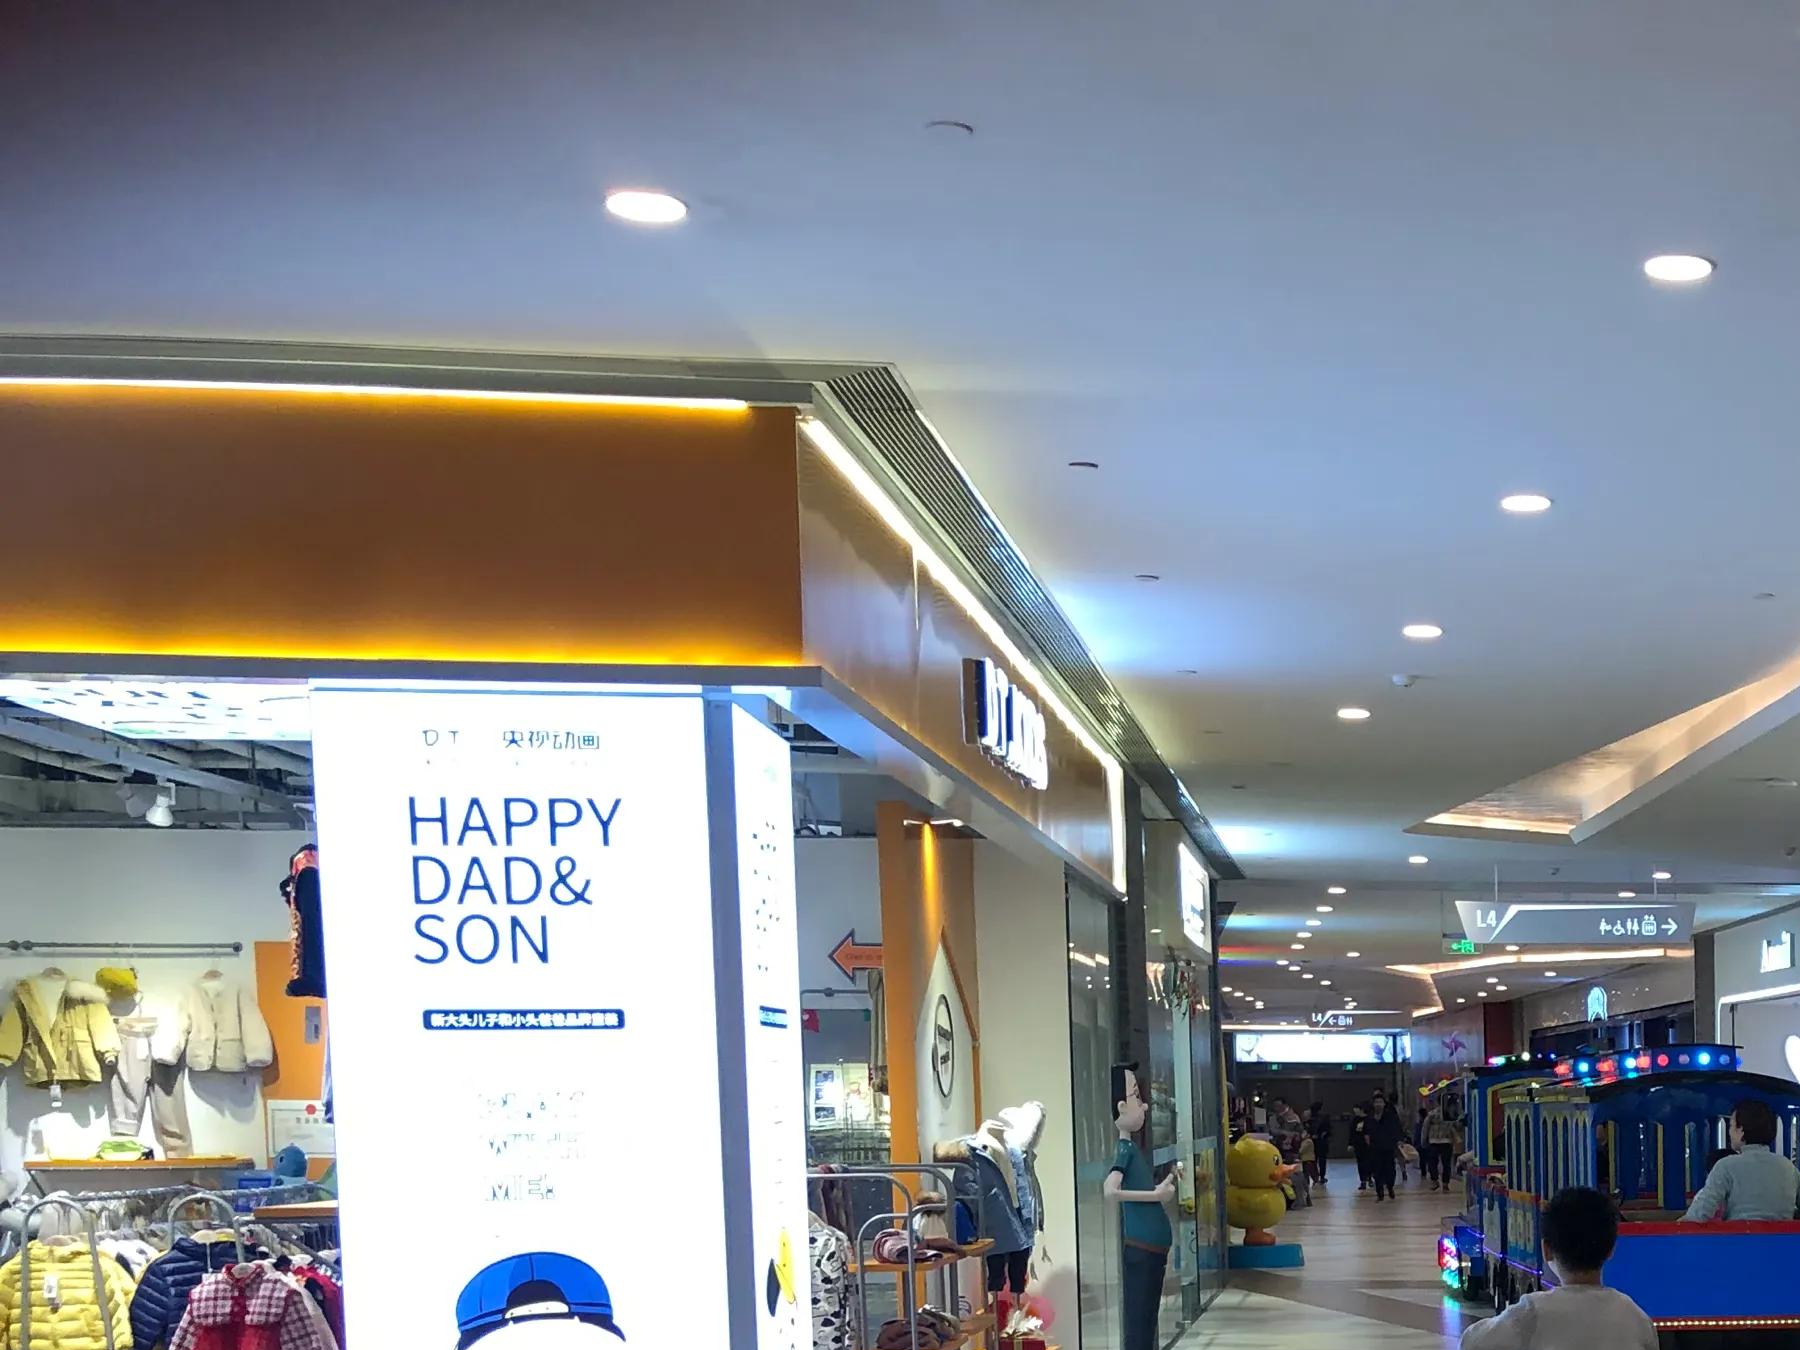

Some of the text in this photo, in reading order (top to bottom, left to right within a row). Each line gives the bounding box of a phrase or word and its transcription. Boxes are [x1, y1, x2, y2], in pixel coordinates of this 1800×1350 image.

[503, 730, 600, 750] 央视动画
[408, 796, 622, 847] HAPPY
[412, 855, 593, 906] DAD&
[414, 913, 549, 965] SON
[1476, 909, 1497, 928] L4
